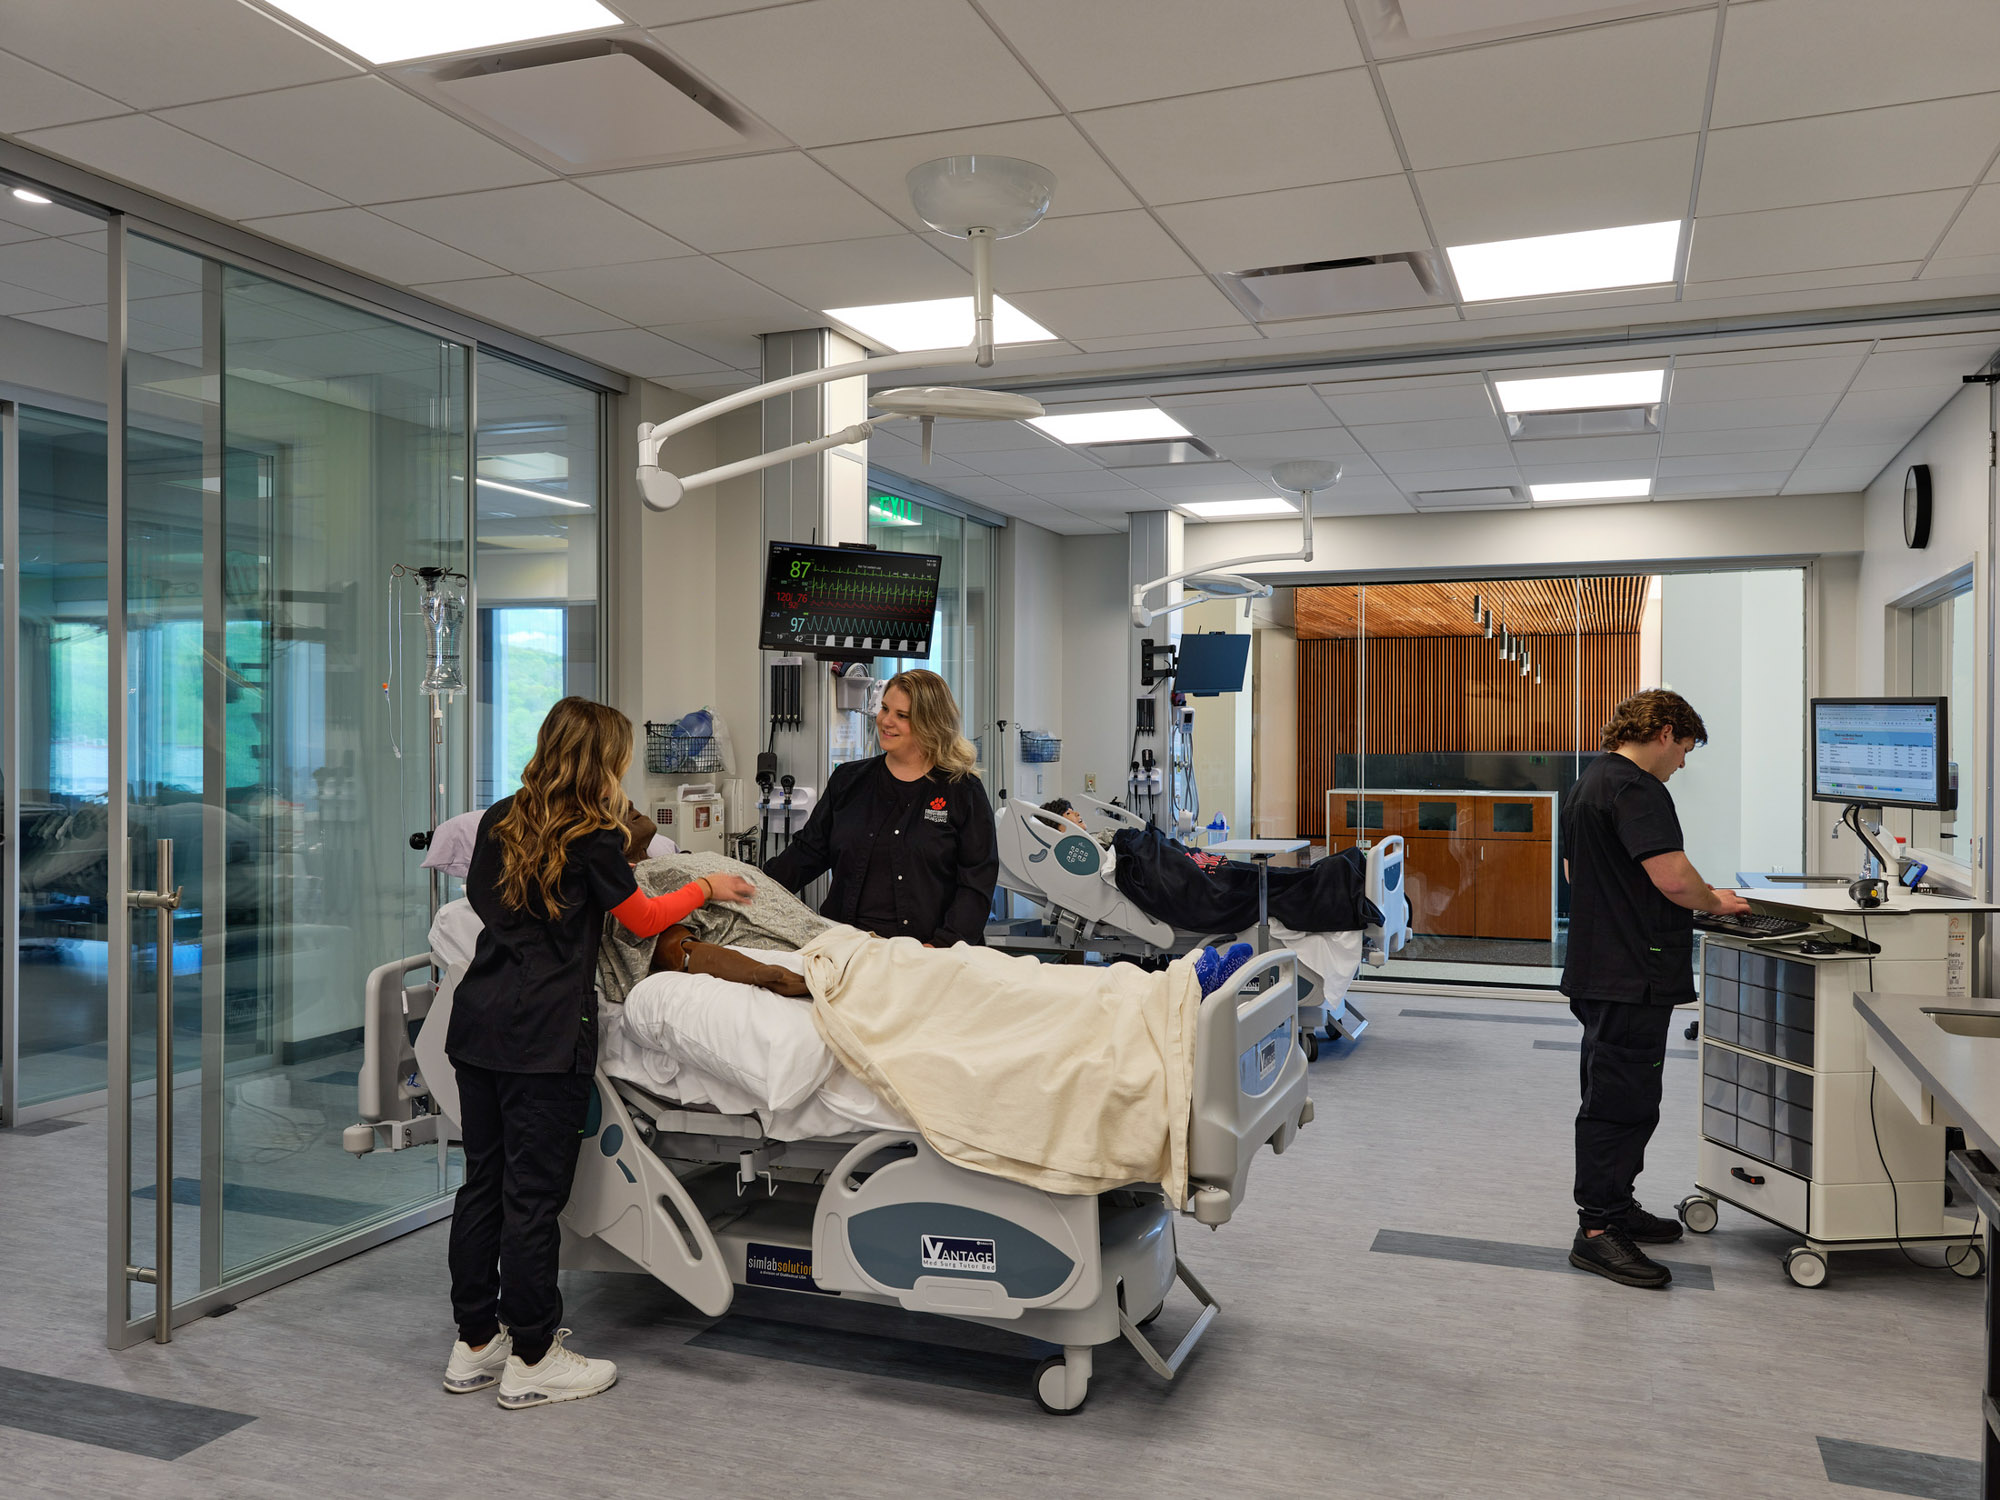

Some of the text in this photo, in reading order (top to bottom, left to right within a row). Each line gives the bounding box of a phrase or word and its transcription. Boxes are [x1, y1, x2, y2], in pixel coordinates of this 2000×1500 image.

[790, 560, 811, 578] 87
[790, 617, 806, 632] 97
[923, 1236, 993, 1263] VANTAGE
